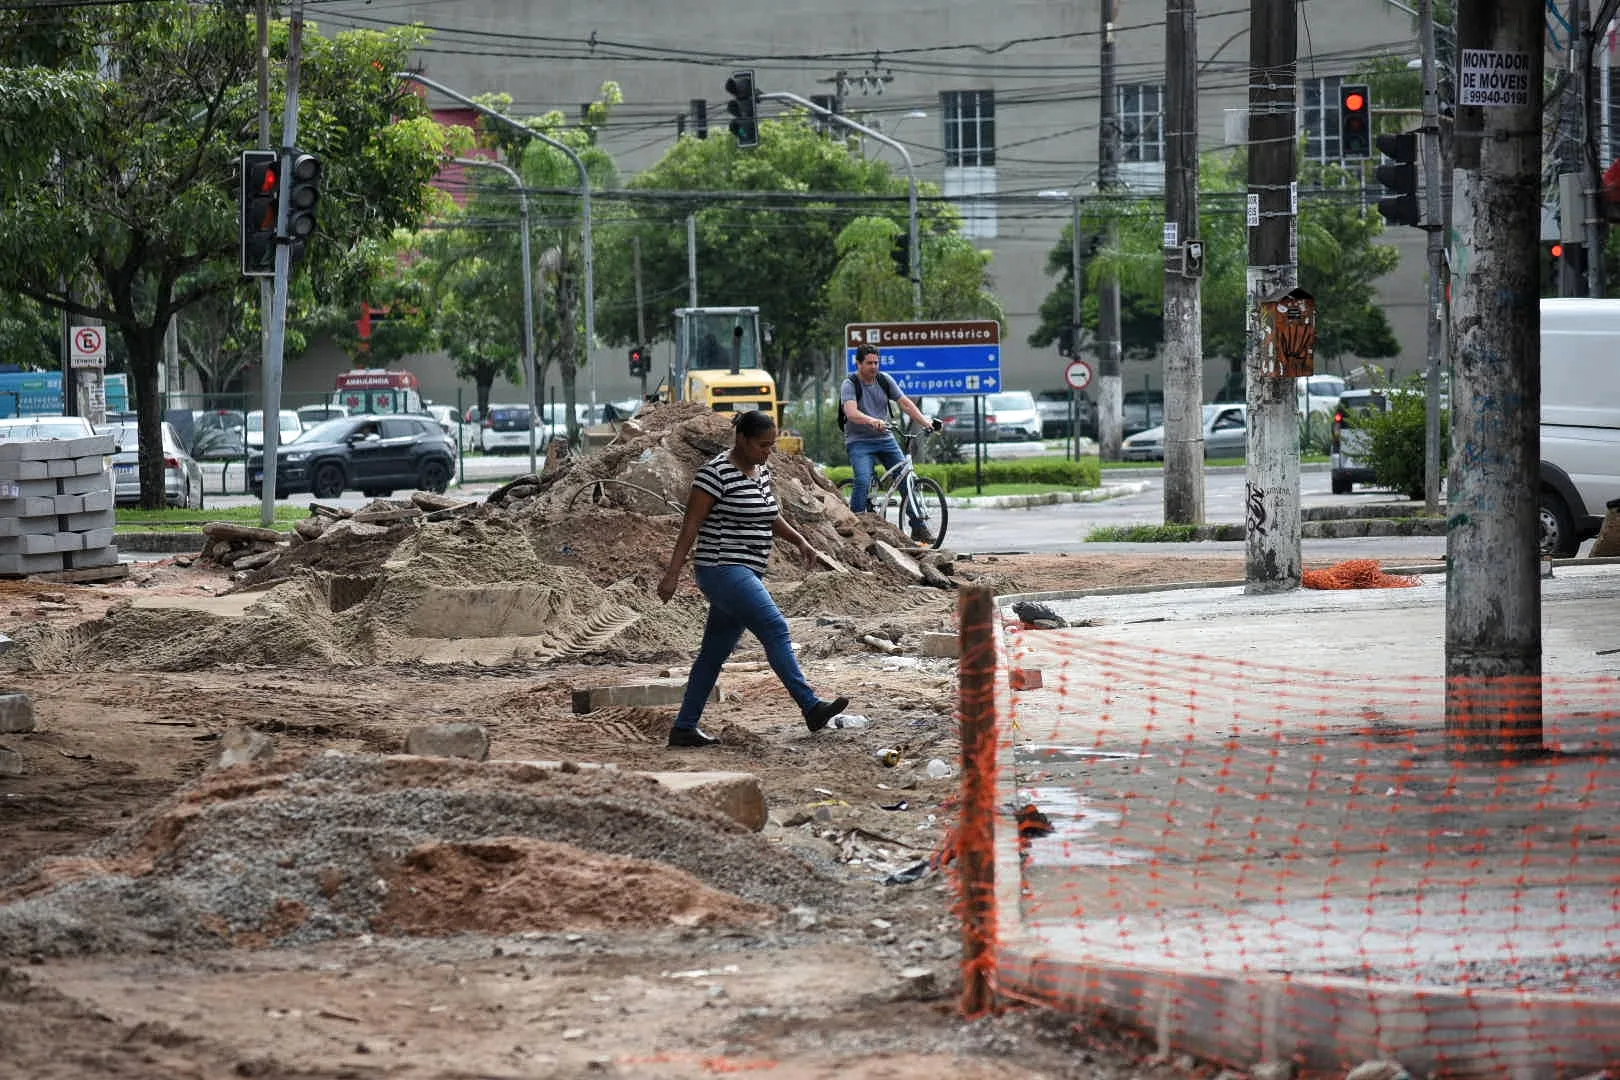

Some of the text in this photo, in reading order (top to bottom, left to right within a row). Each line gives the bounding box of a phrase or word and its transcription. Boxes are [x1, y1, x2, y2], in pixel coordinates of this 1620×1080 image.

[1464, 52, 1528, 70] MONTADOR
[1464, 70, 1528, 90] DE MÓVEIS
[883, 328, 991, 341] Centro Histórico
[898, 378, 962, 391] Aeroporto
